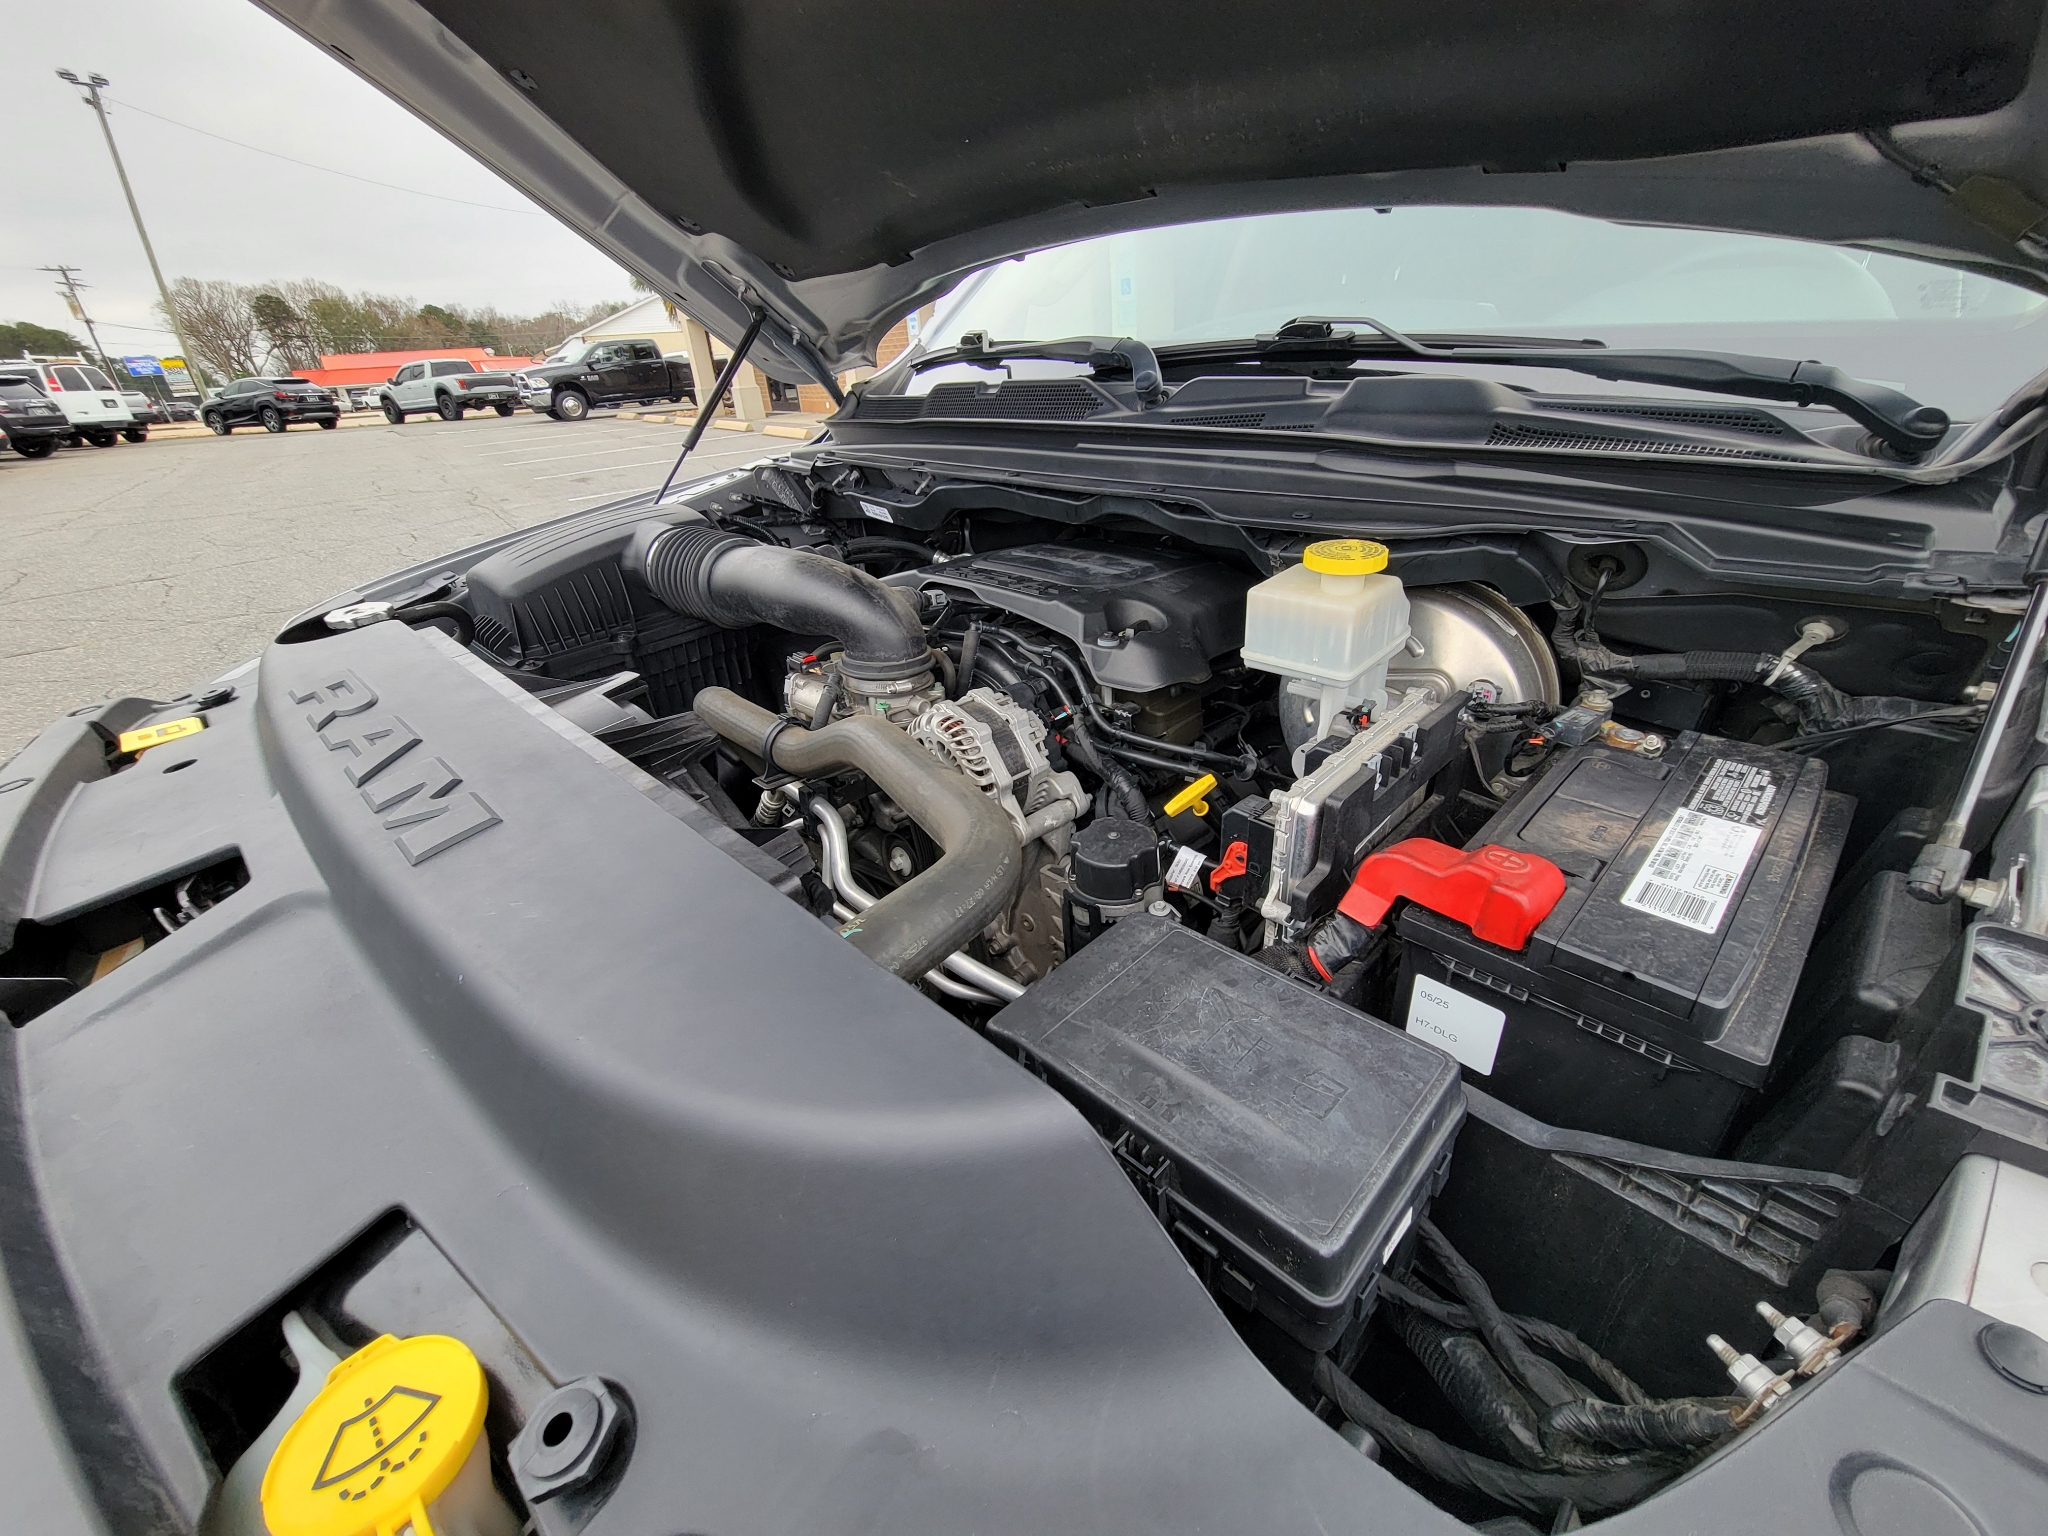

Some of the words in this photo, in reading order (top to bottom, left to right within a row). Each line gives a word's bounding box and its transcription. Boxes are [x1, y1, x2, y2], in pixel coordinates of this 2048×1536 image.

[288, 668, 503, 866] RAM
[1420, 990, 1450, 1009] 05/25
[1415, 1016, 1458, 1043] H7-DLG
